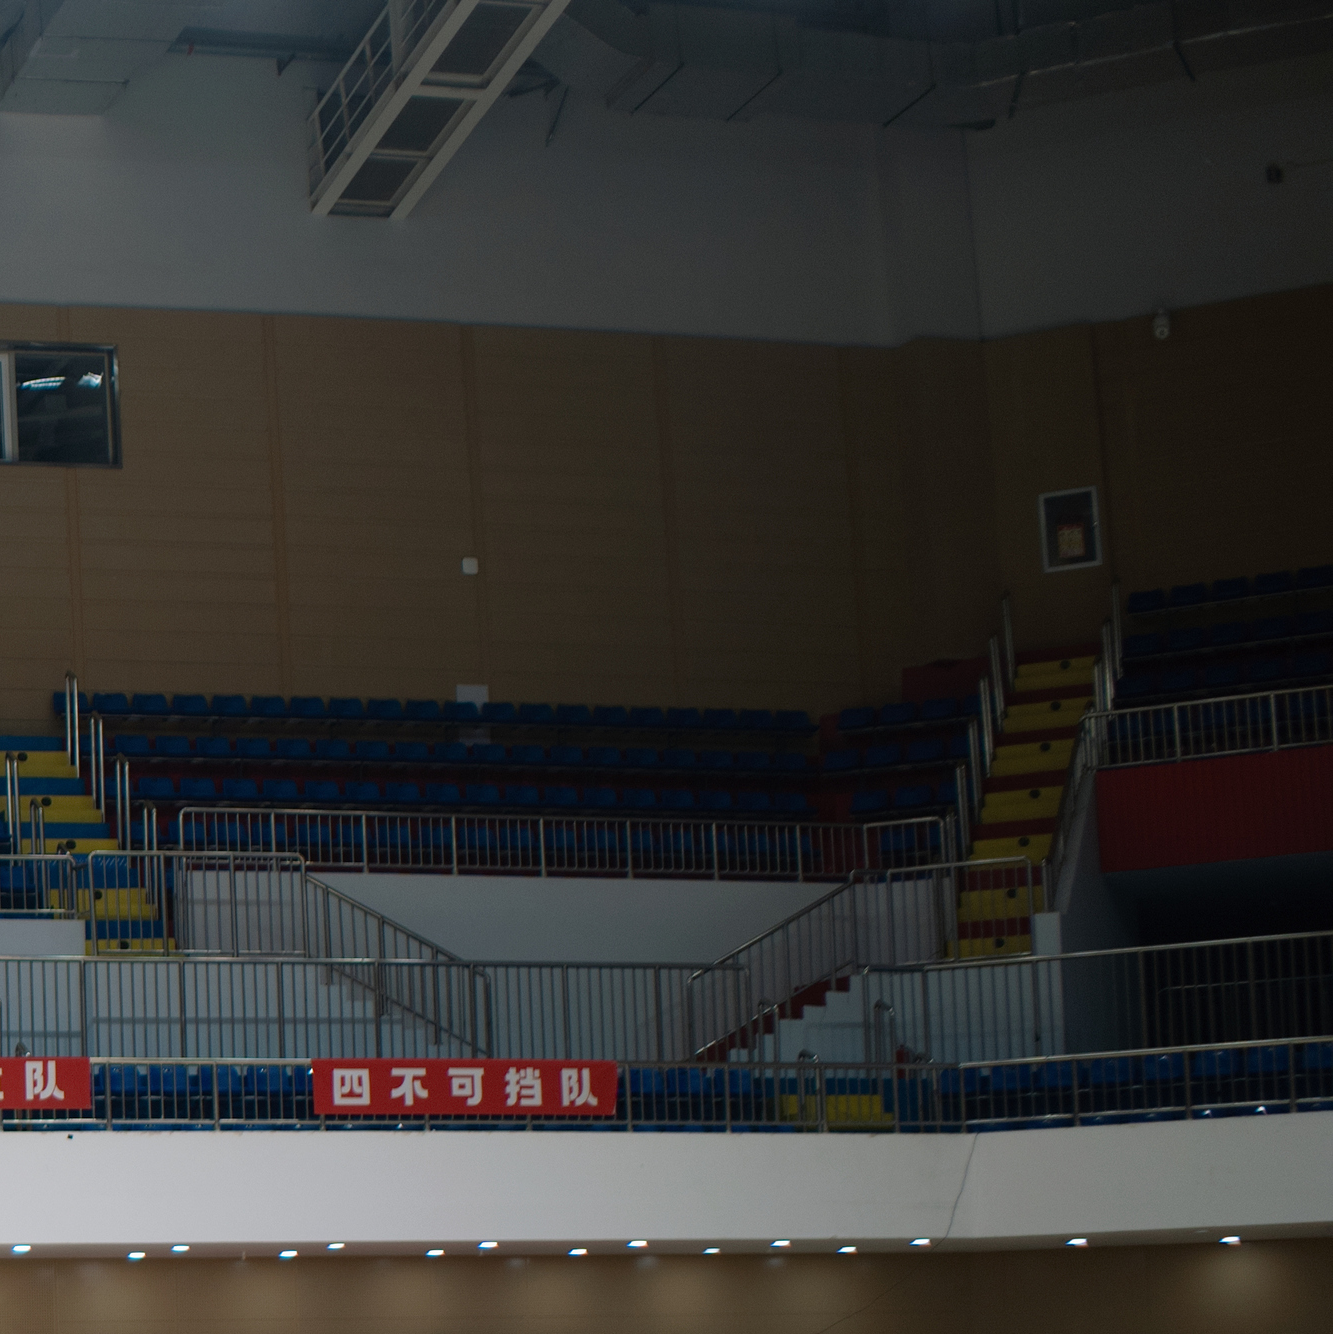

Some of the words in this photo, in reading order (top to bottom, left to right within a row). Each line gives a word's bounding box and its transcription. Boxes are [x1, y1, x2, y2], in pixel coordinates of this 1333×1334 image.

[331, 1067, 599, 1107] 四不可挡队
